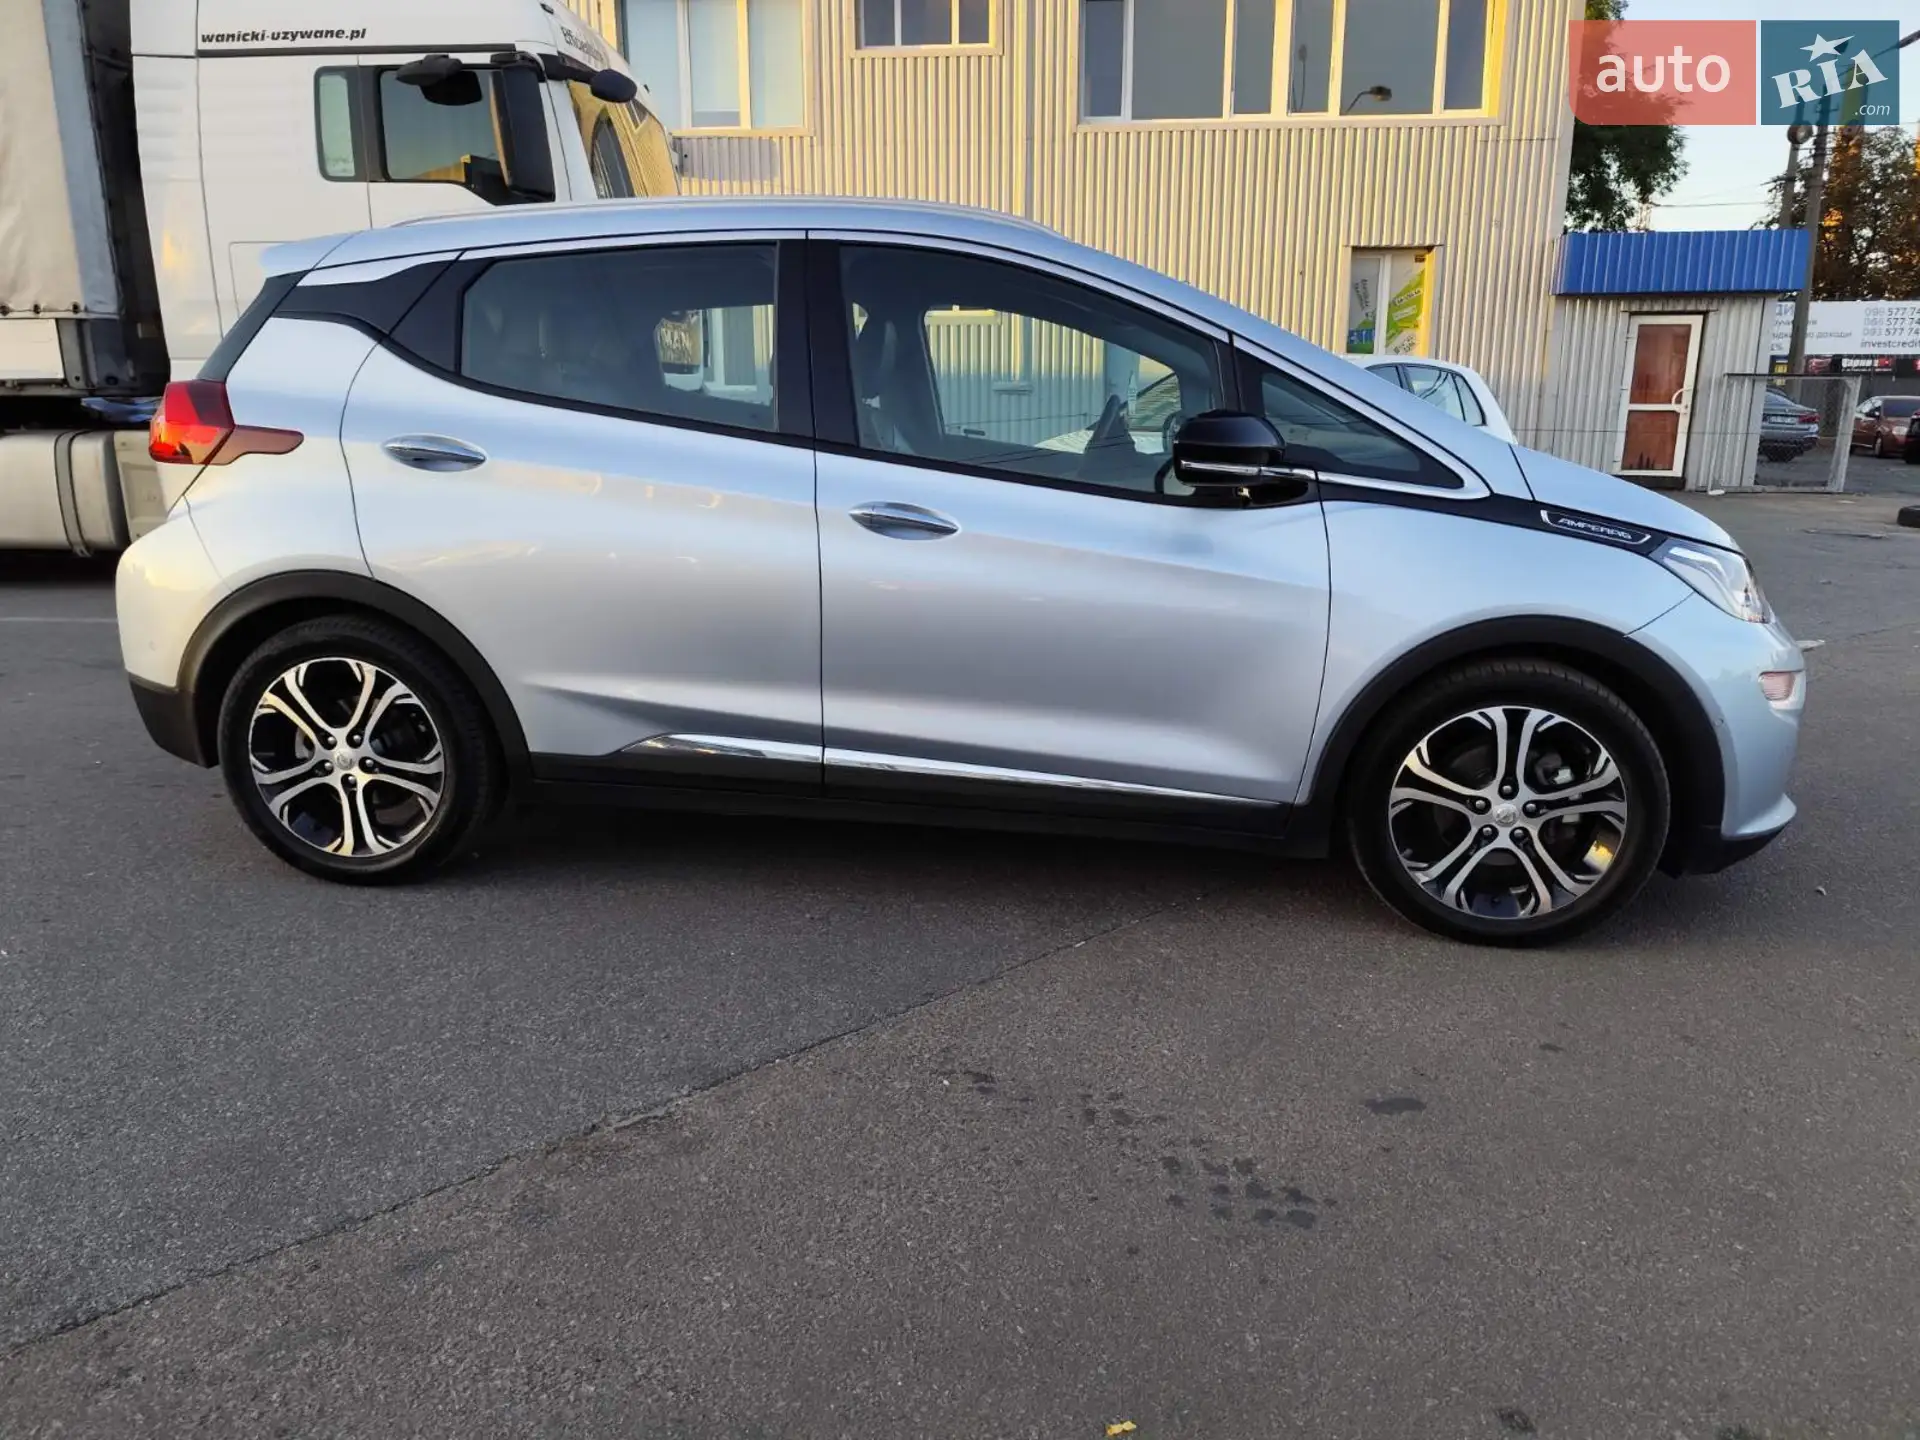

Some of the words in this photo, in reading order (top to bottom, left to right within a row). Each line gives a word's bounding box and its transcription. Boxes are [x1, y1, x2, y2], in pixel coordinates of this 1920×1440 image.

[201, 27, 367, 43] wanicki-uzywane.pl
[1887, 306, 1908, 317] 577
[1886, 317, 1906, 326] 577
[1884, 327, 1905, 337] 577
